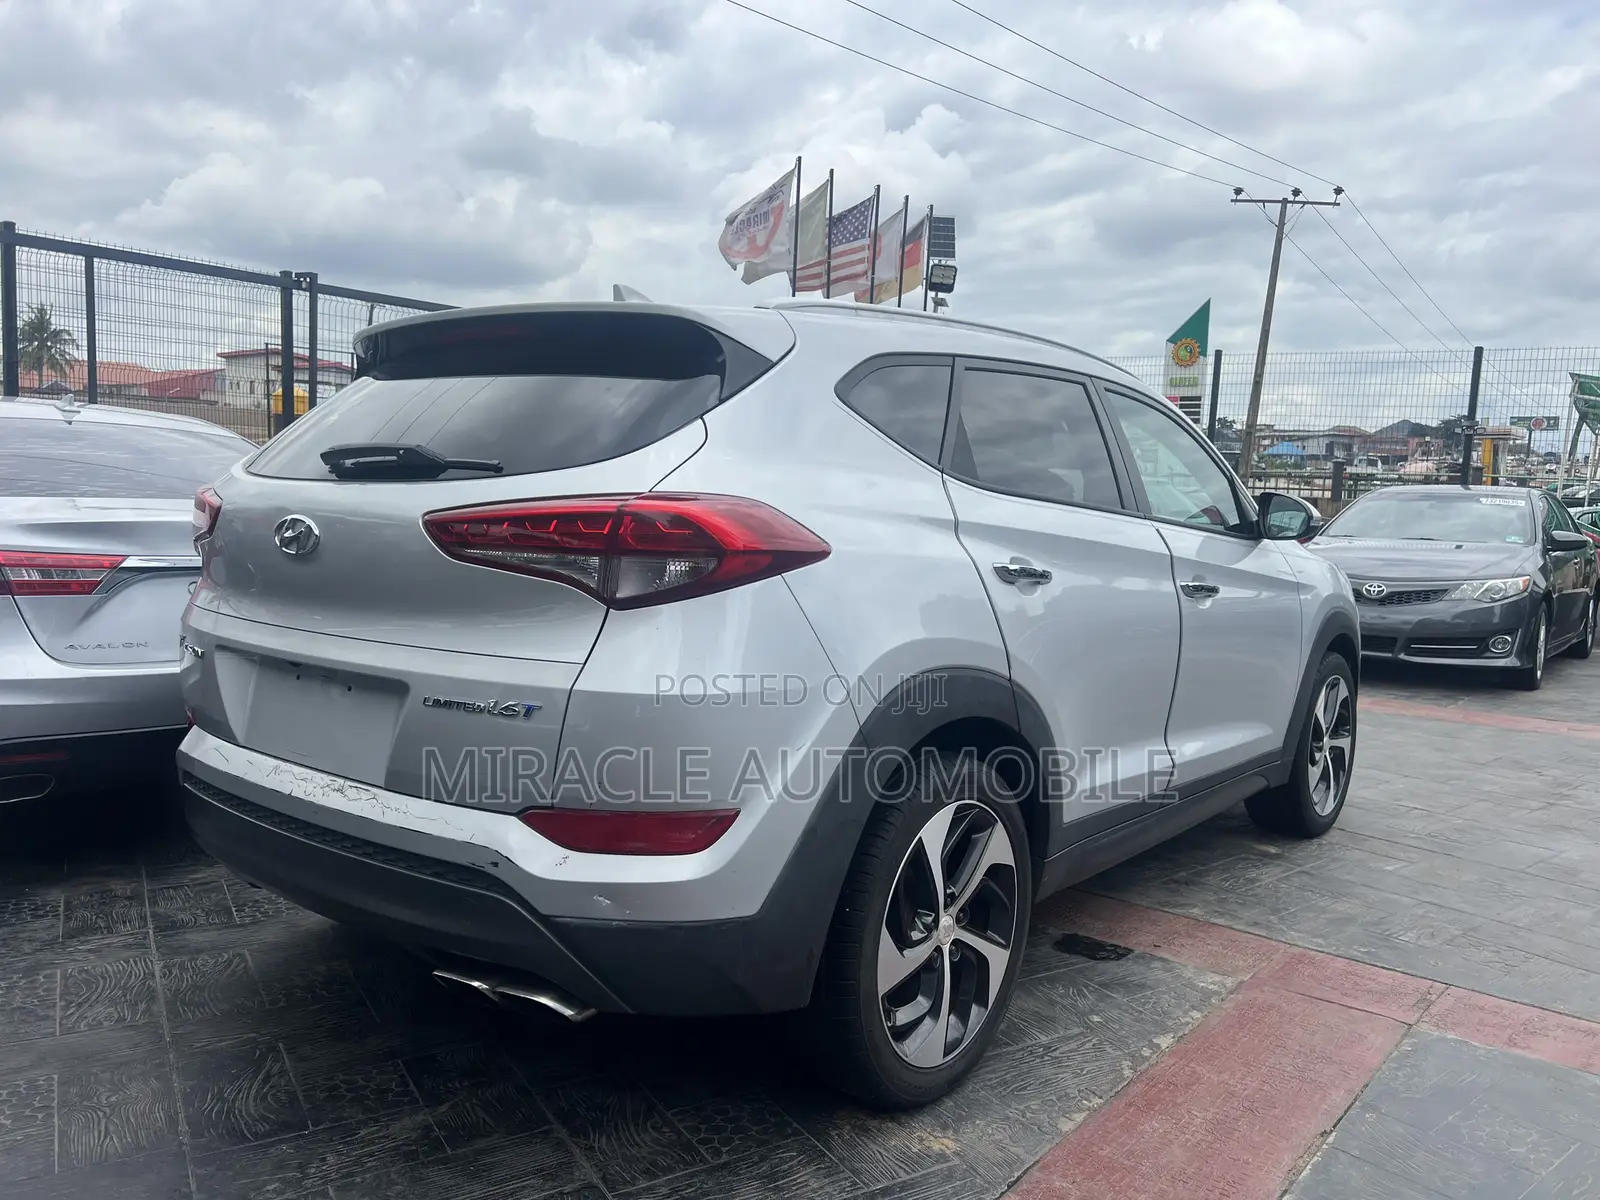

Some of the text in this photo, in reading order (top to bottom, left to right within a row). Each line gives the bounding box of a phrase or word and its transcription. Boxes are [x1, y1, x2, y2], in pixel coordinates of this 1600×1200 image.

[63, 641, 149, 651] AVALON
[422, 695, 542, 720] LIMITED 1.6T
